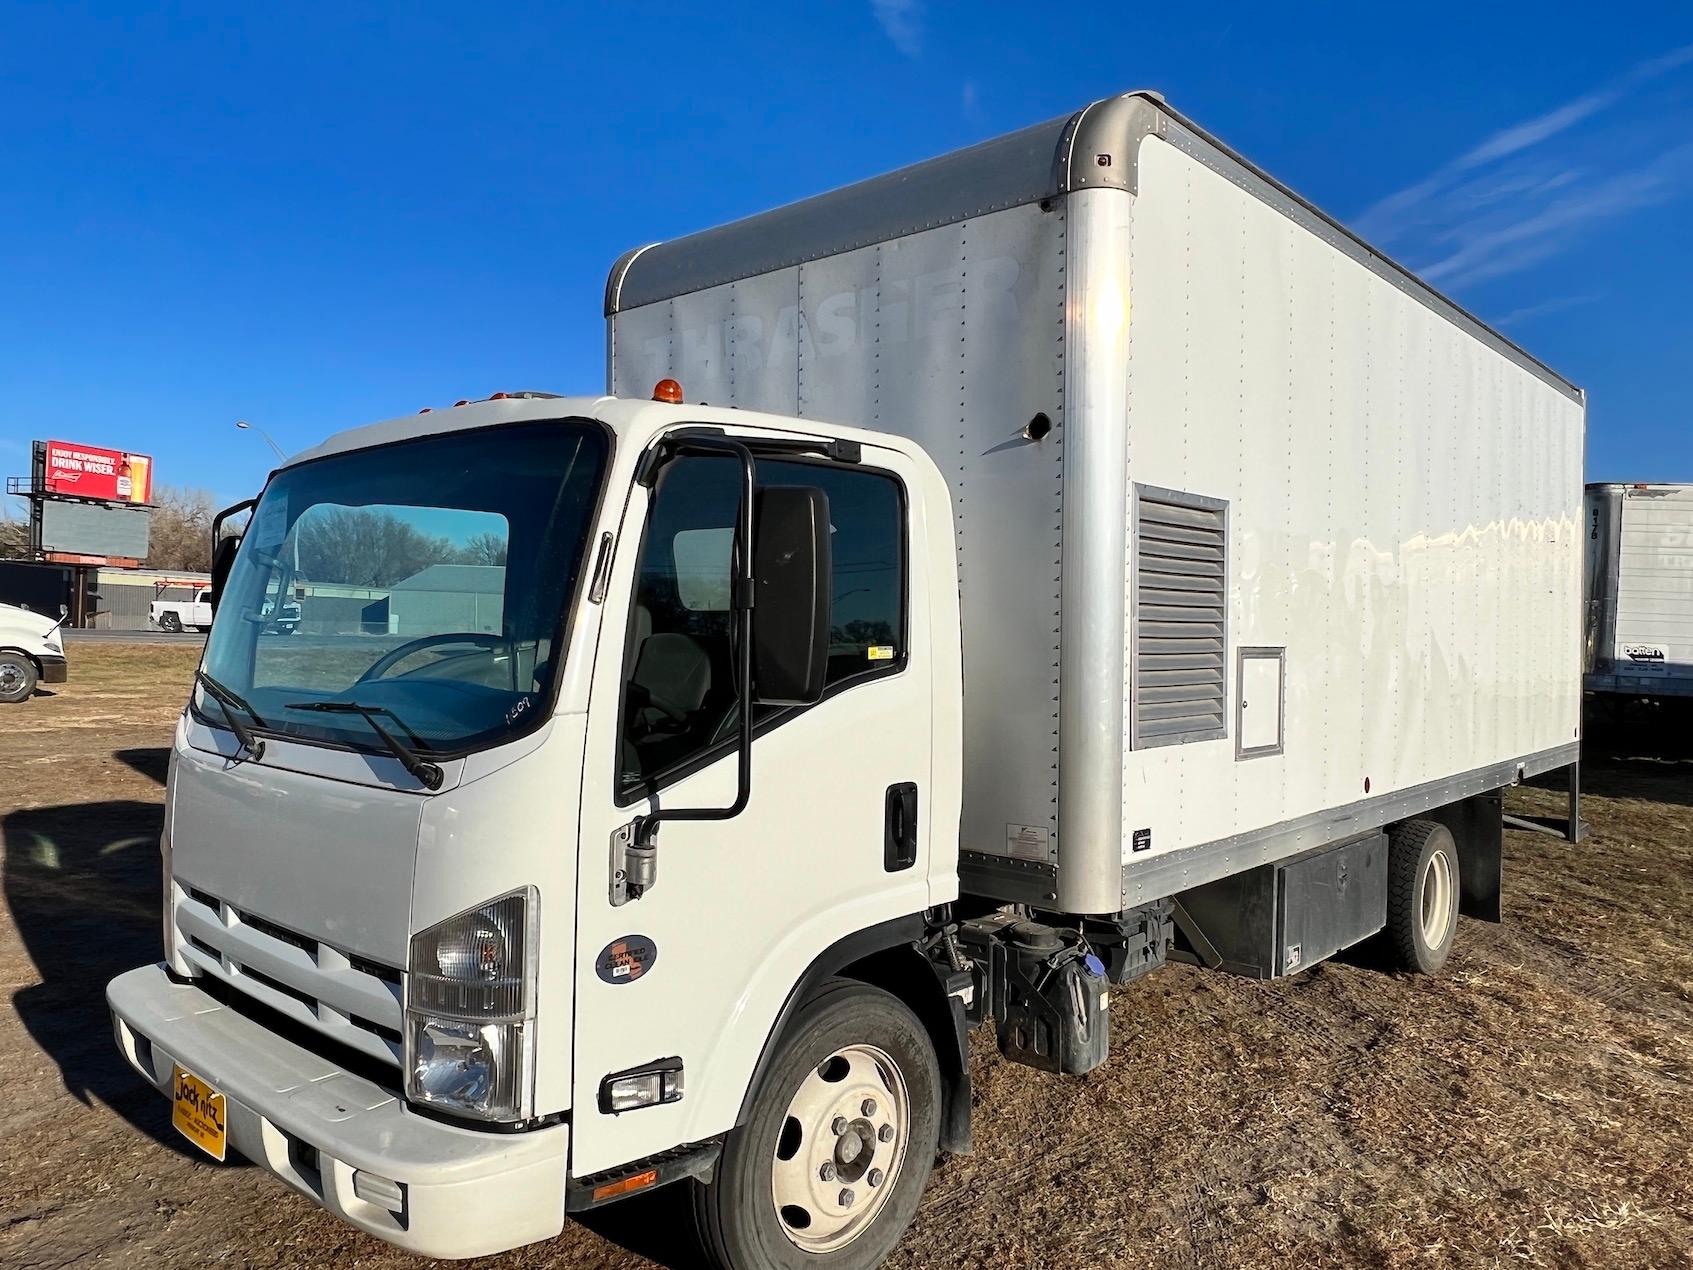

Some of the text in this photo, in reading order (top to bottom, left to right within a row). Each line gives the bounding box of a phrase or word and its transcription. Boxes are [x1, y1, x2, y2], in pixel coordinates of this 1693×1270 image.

[51, 456, 83, 471] DRINK
[83, 461, 117, 476] WISER.
[605, 958, 631, 970] CLEAN
[175, 1080, 199, 1112] Jack
